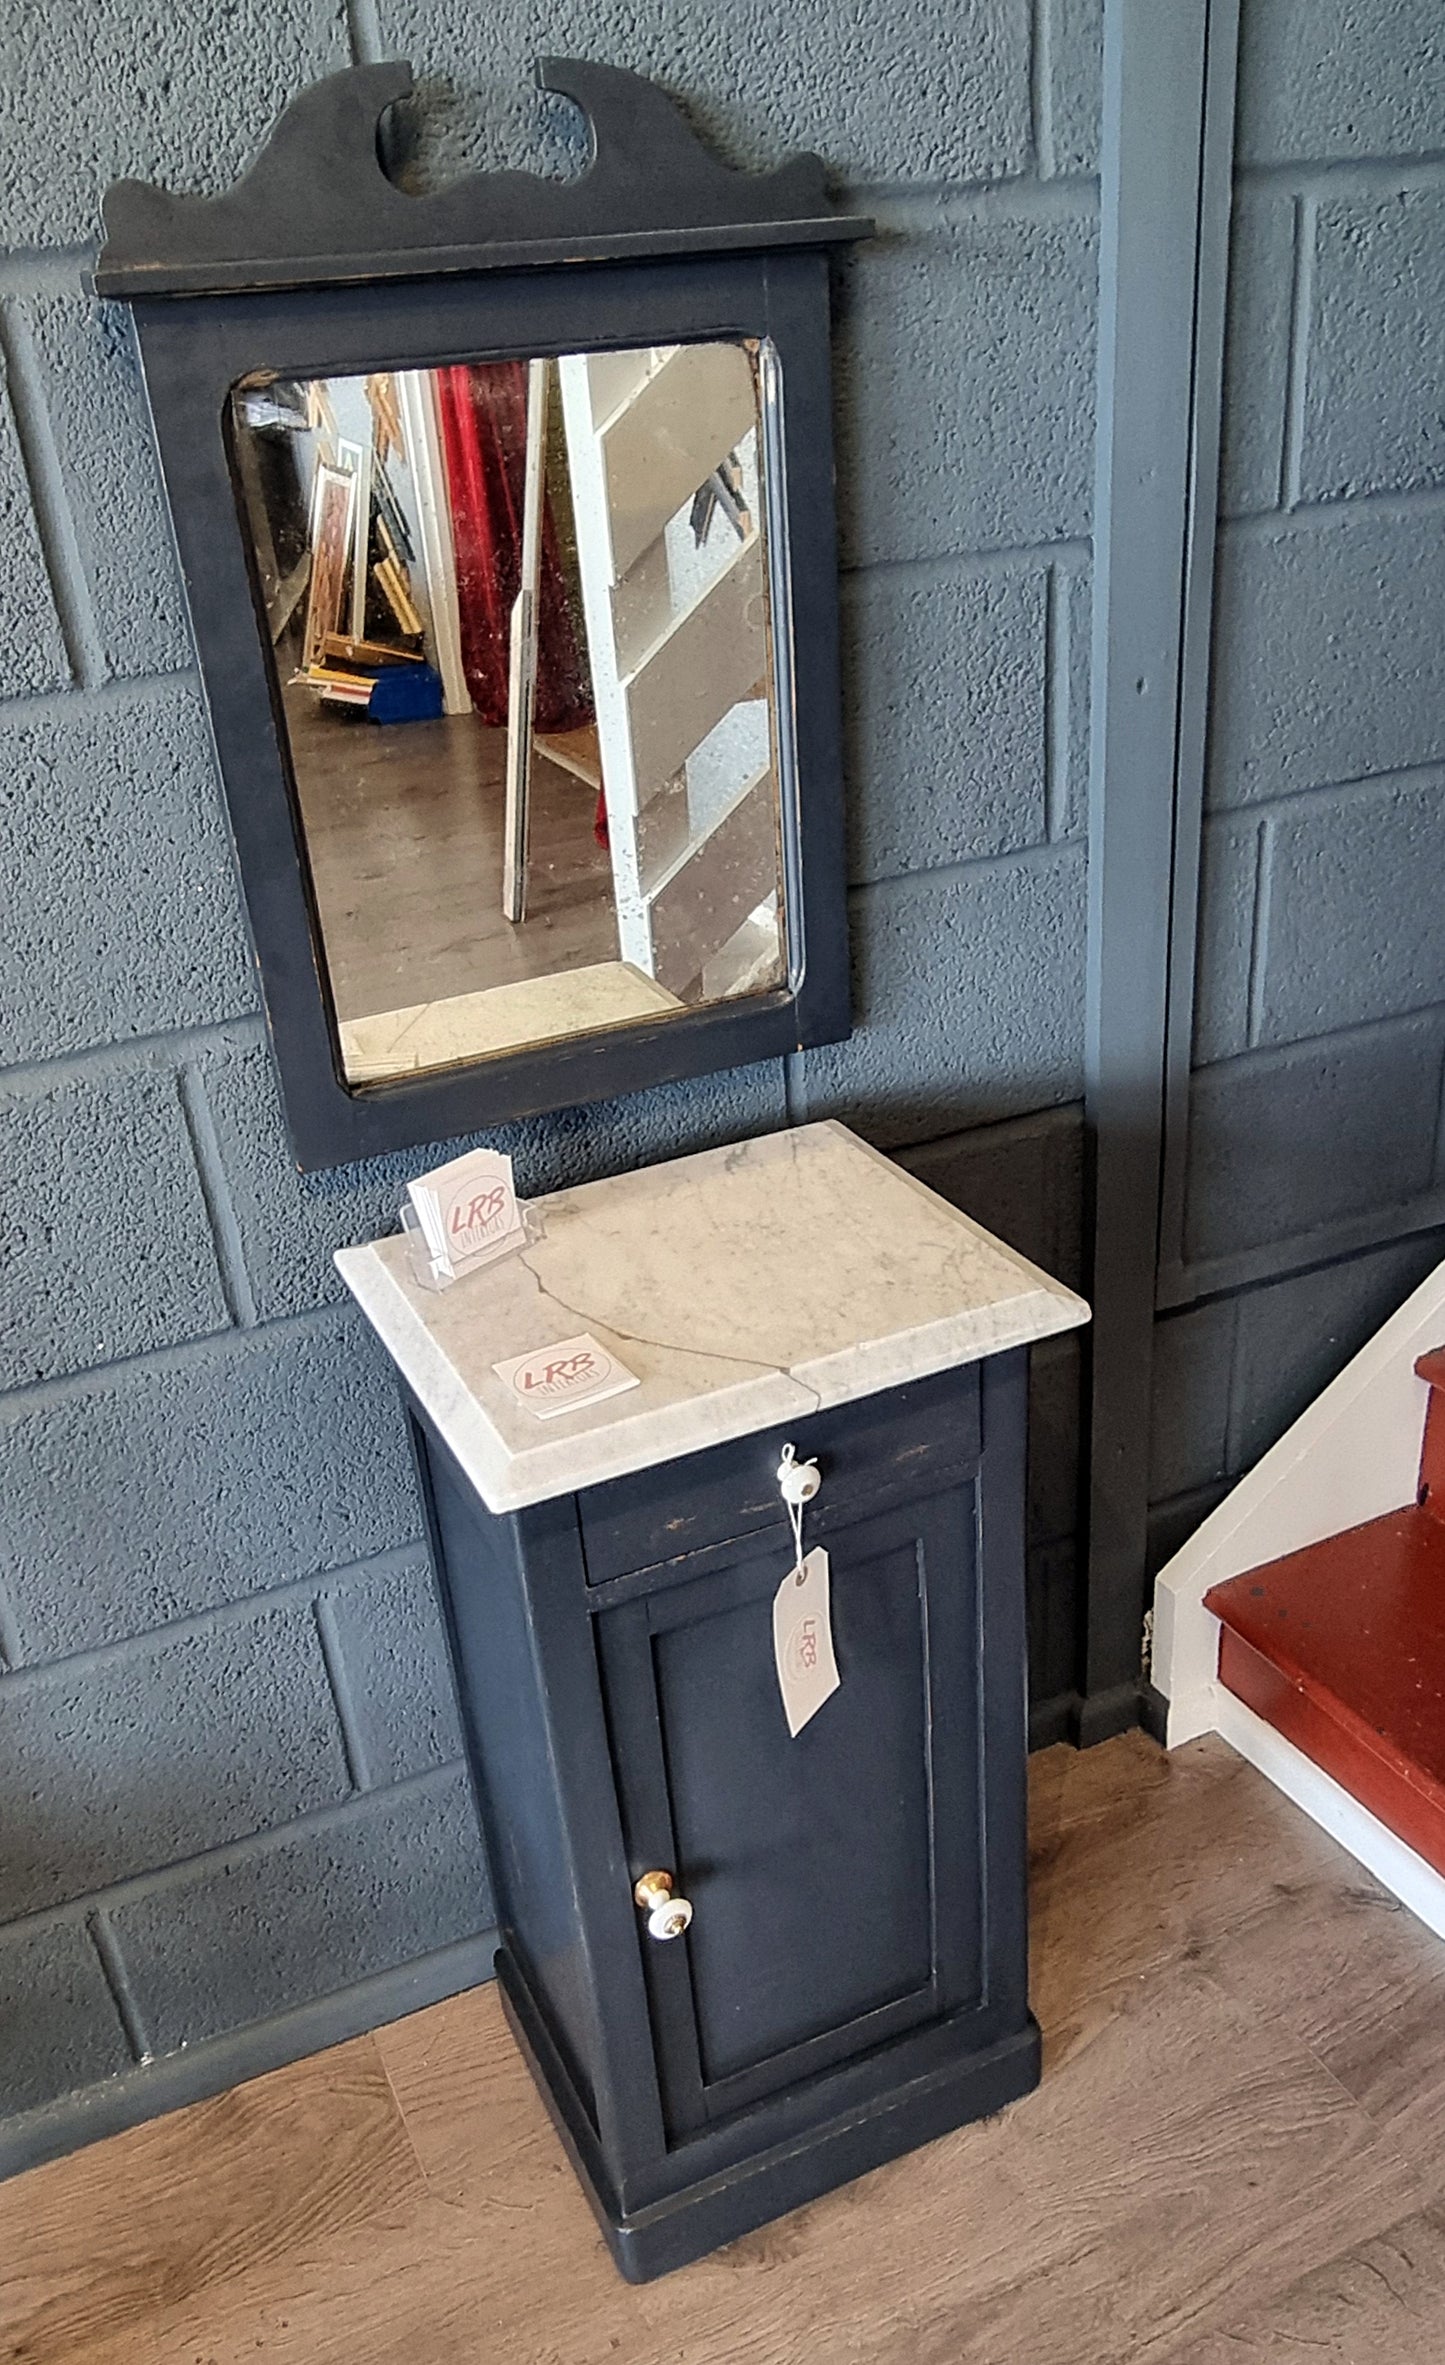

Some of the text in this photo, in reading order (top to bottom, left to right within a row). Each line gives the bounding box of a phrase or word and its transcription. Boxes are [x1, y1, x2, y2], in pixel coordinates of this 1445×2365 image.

[452, 1187, 505, 1234] LRB
[525, 1353, 595, 1389] LRB
[800, 1619, 817, 1667] LRB
